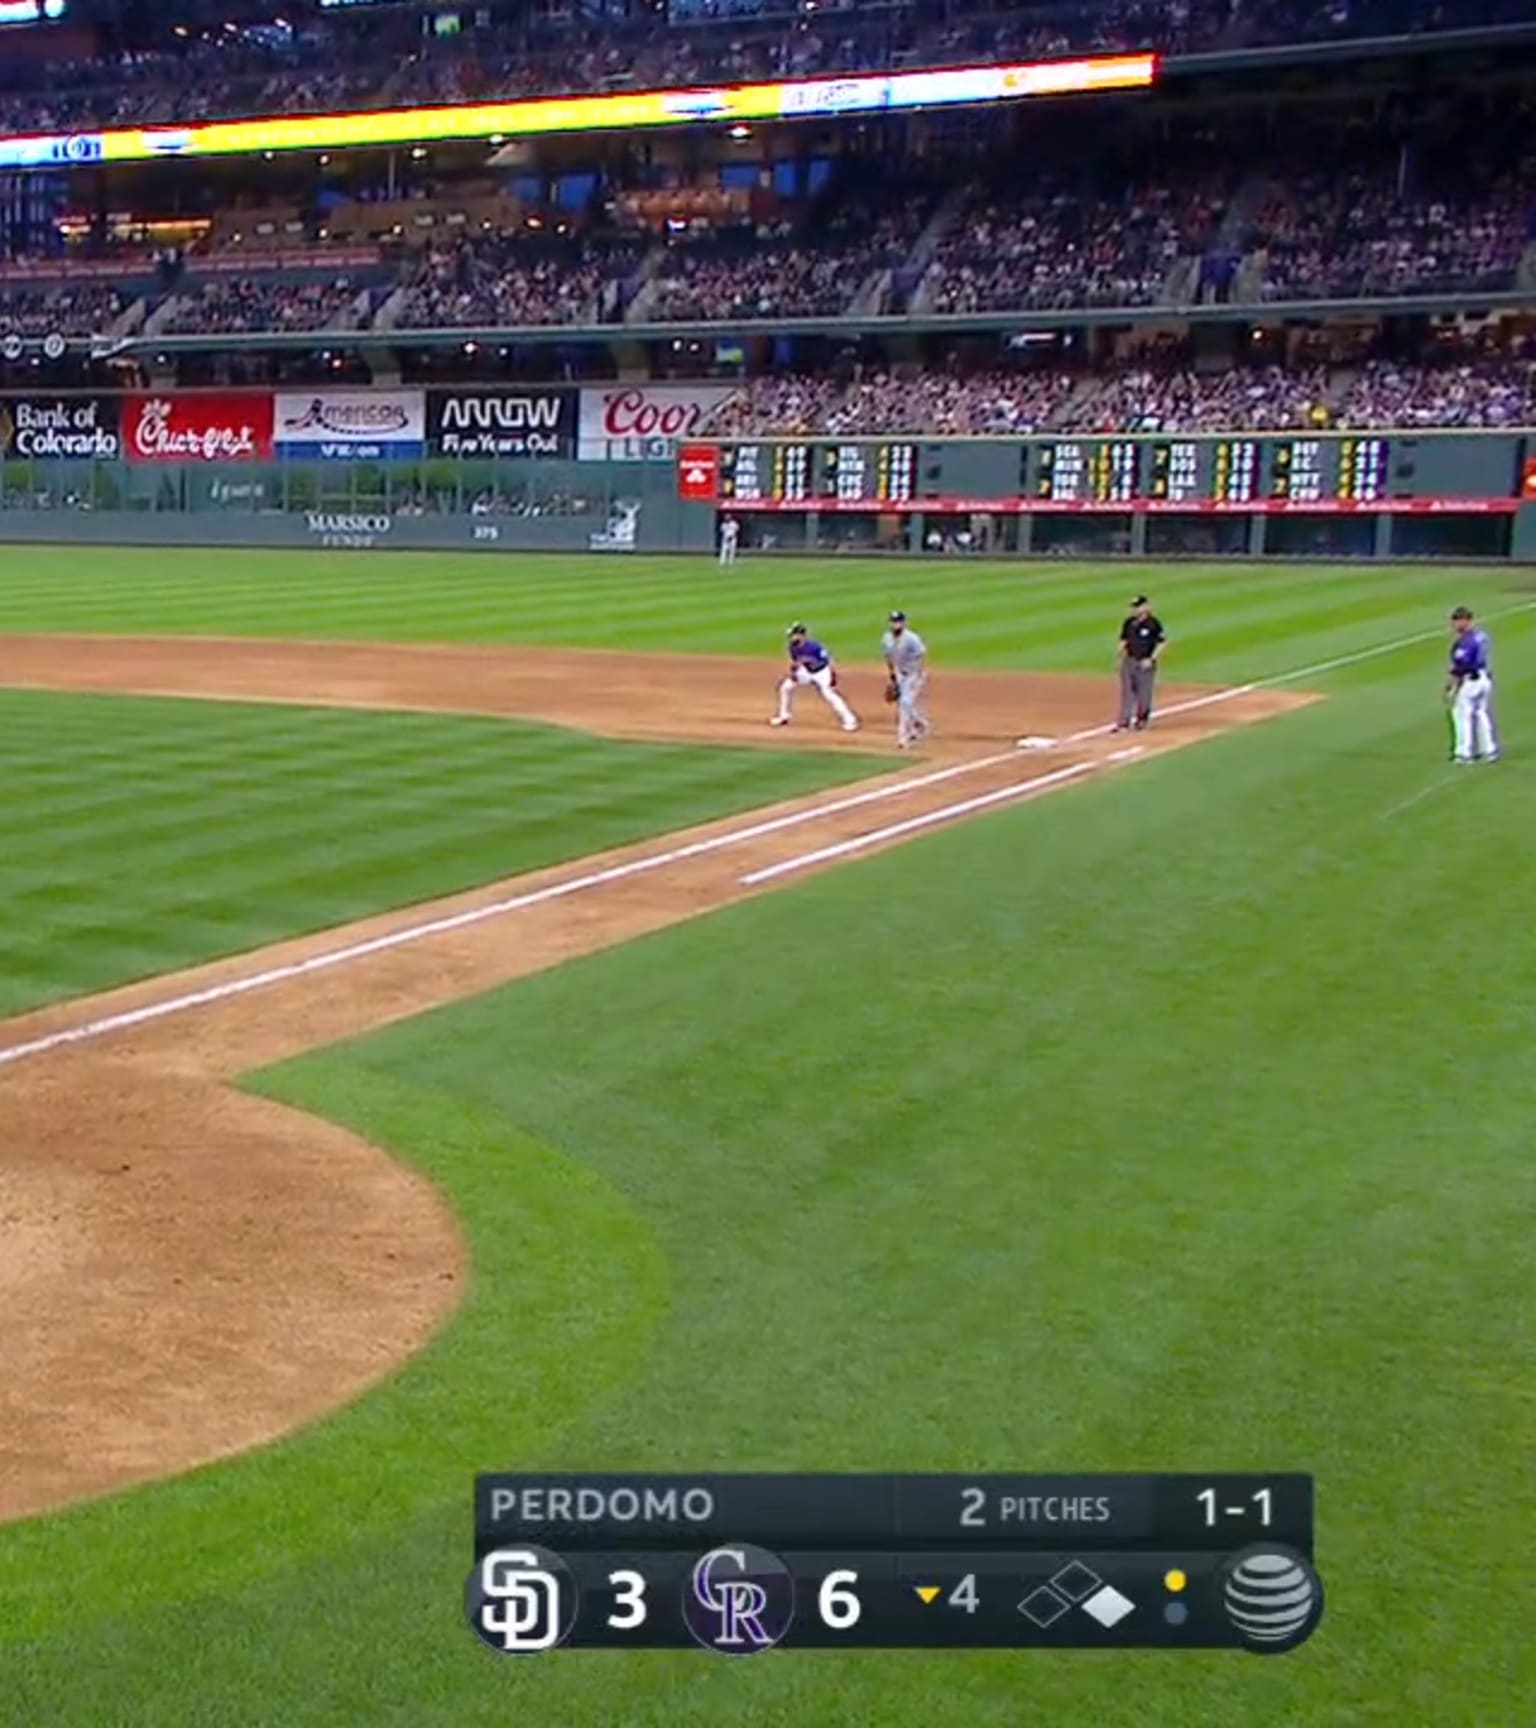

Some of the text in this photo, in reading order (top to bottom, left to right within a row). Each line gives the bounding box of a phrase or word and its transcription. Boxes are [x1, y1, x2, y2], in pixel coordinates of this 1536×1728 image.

[16, 402, 98, 429] Bank of
[442, 398, 560, 428] ARROW
[16, 428, 117, 455] Colorado
[442, 433, 559, 452] Five Years Out
[308, 513, 391, 532] MARSICO
